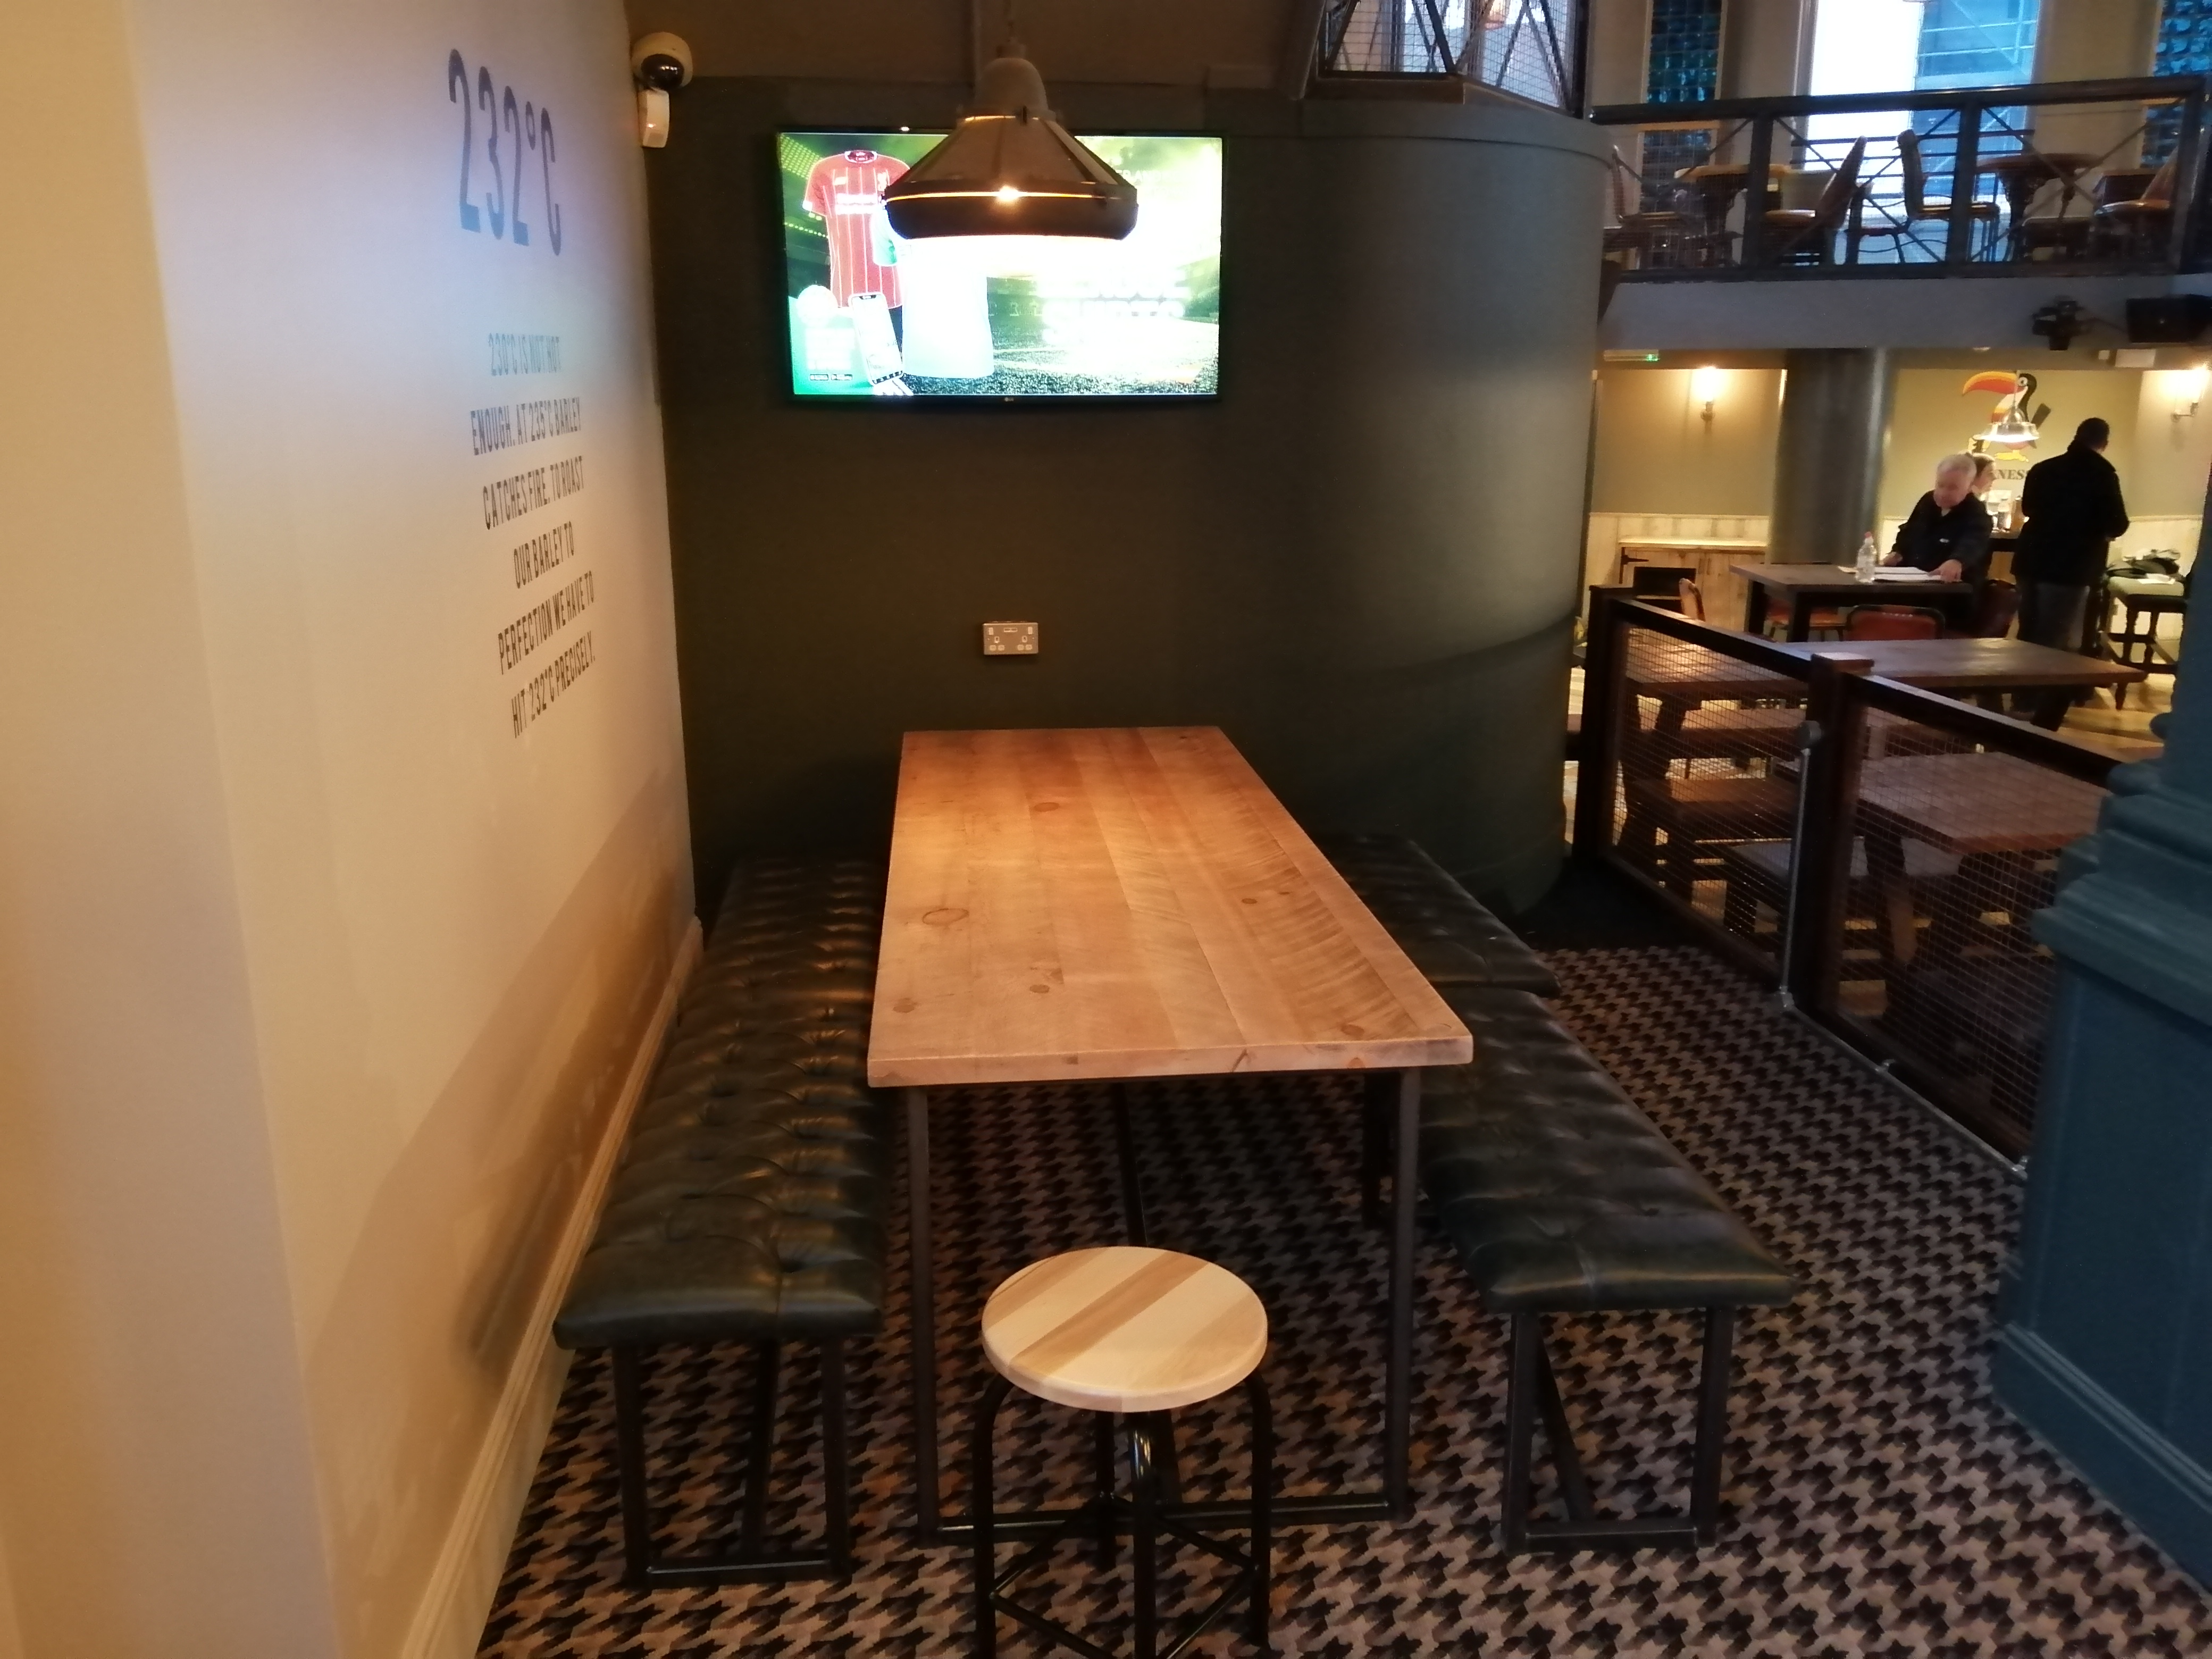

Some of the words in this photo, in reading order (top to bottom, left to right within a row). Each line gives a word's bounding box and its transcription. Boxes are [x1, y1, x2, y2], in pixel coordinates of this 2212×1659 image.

[448, 49, 561, 256] 232°C
[470, 405, 515, 456] ENOUGH.
[516, 403, 527, 445] AT
[553, 397, 581, 436] BARLEY
[483, 474, 527, 530] CATCHES
[527, 467, 550, 511] FIRE.
[550, 463, 561, 501] TO
[560, 455, 584, 497] ROAST
[514, 542, 533, 589] OUR
[532, 526, 564, 578] BARLEY
[564, 521, 574, 558] TO
[498, 598, 553, 675] PERFECTION
[552, 589, 566, 631] WE
[565, 576, 585, 622] HAVE
[584, 570, 594, 606] TO
[512, 688, 527, 739] HIT
[554, 630, 596, 697] PRECISELY.
